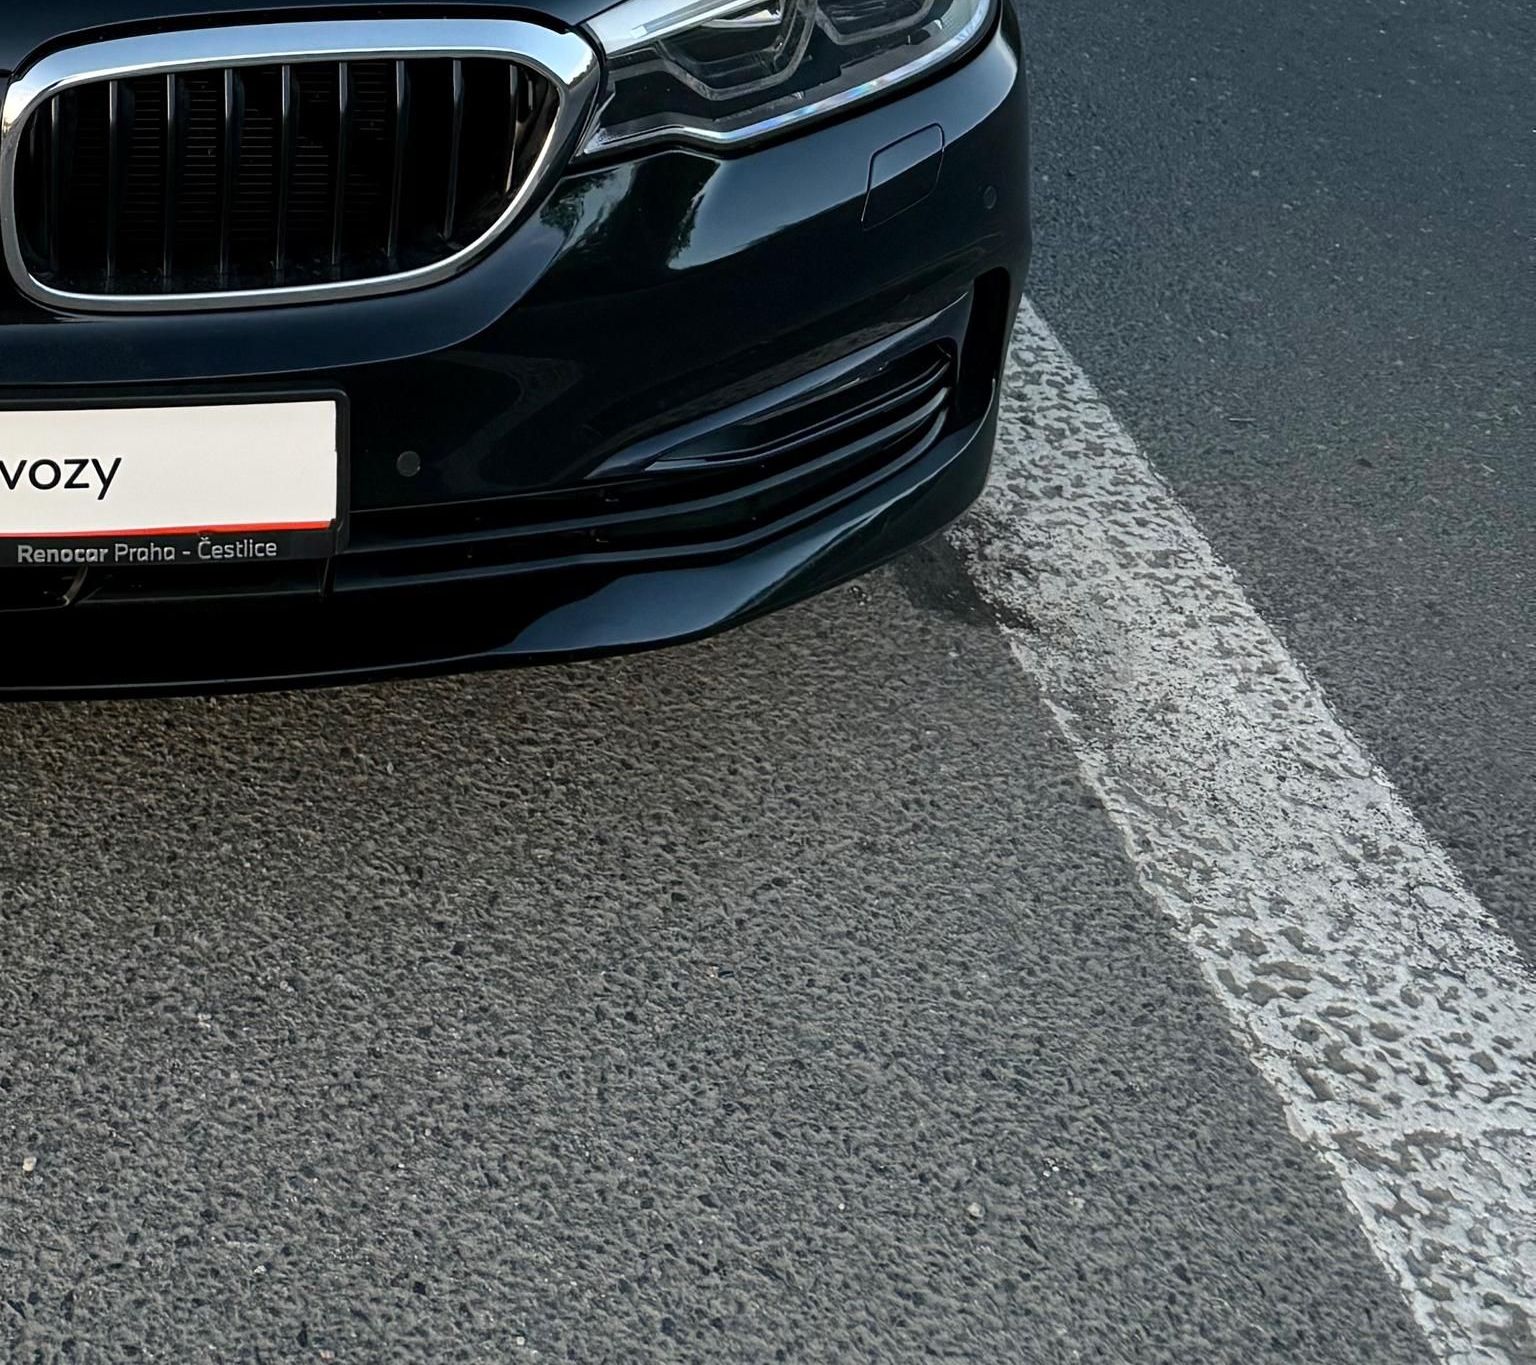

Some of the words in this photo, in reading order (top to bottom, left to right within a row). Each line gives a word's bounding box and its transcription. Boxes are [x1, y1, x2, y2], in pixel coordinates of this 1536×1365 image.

[17, 544, 109, 563] Renocar
[114, 543, 176, 562] Praha
[197, 536, 277, 559] Čestlice
